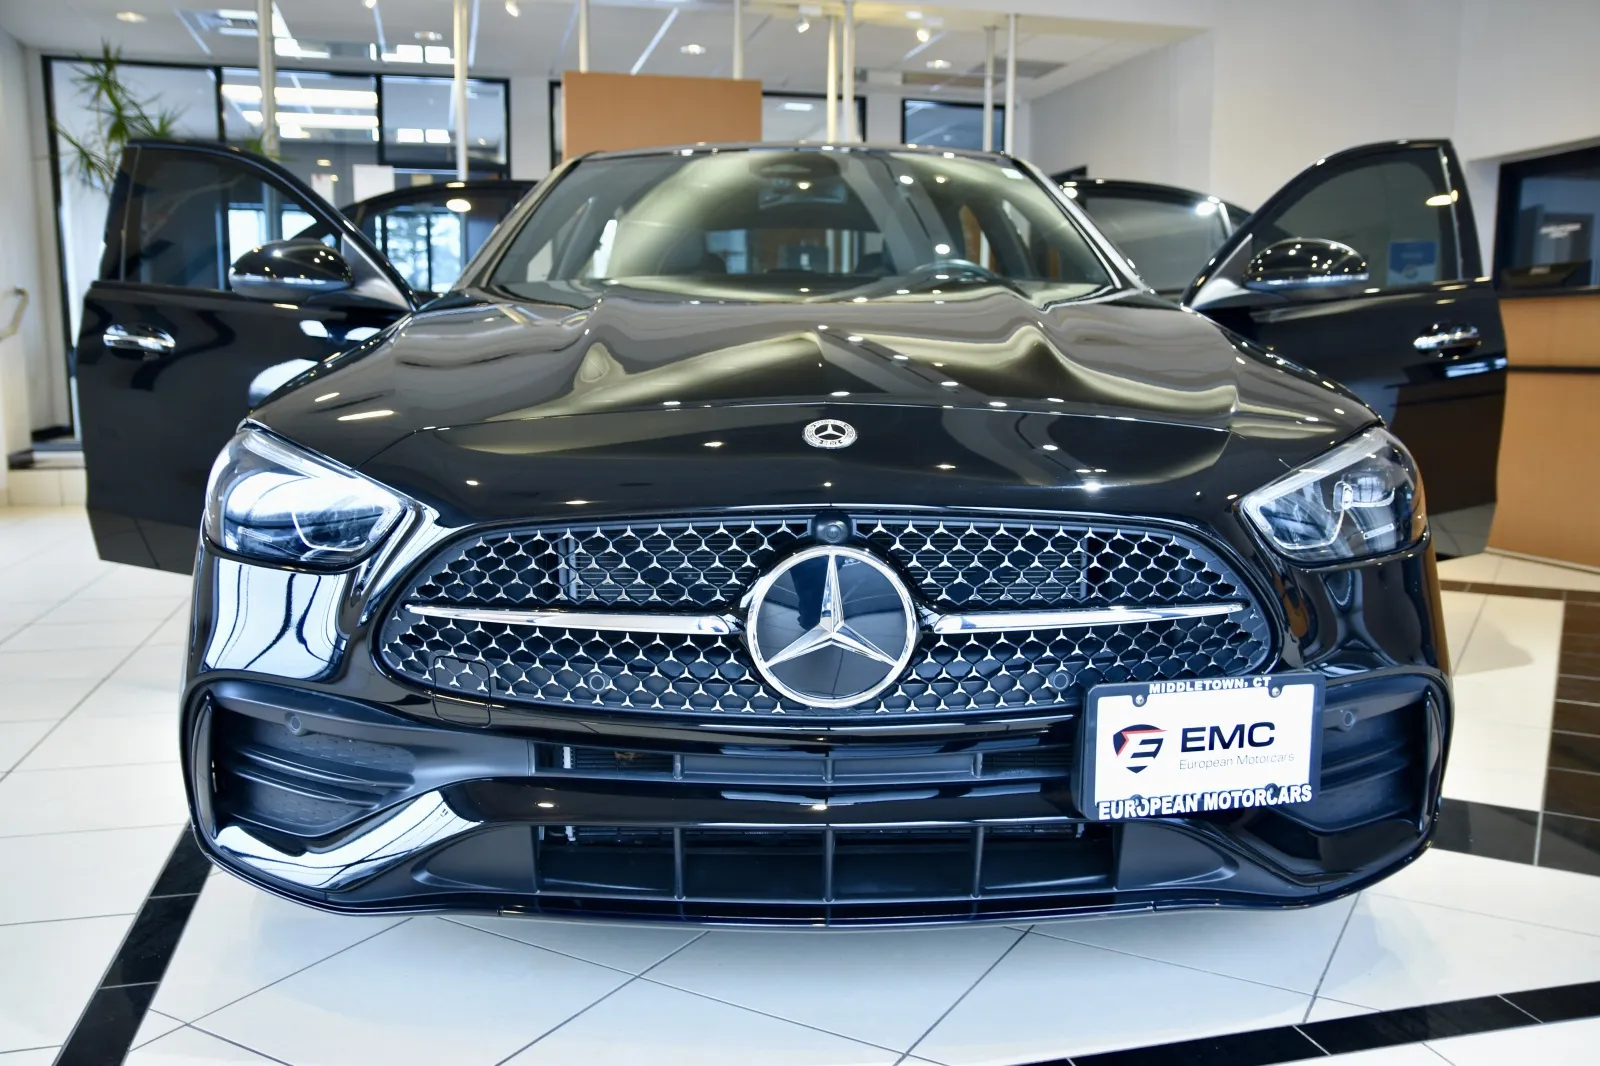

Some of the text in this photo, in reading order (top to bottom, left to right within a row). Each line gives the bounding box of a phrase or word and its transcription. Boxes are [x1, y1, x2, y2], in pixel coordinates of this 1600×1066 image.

[1149, 676, 1272, 694] MIDDLETOWN, CT
[1181, 721, 1275, 752] EMC
[1179, 753, 1295, 770] European Motorcars
[1098, 784, 1313, 821] EUROPEAN MOTORCARS
